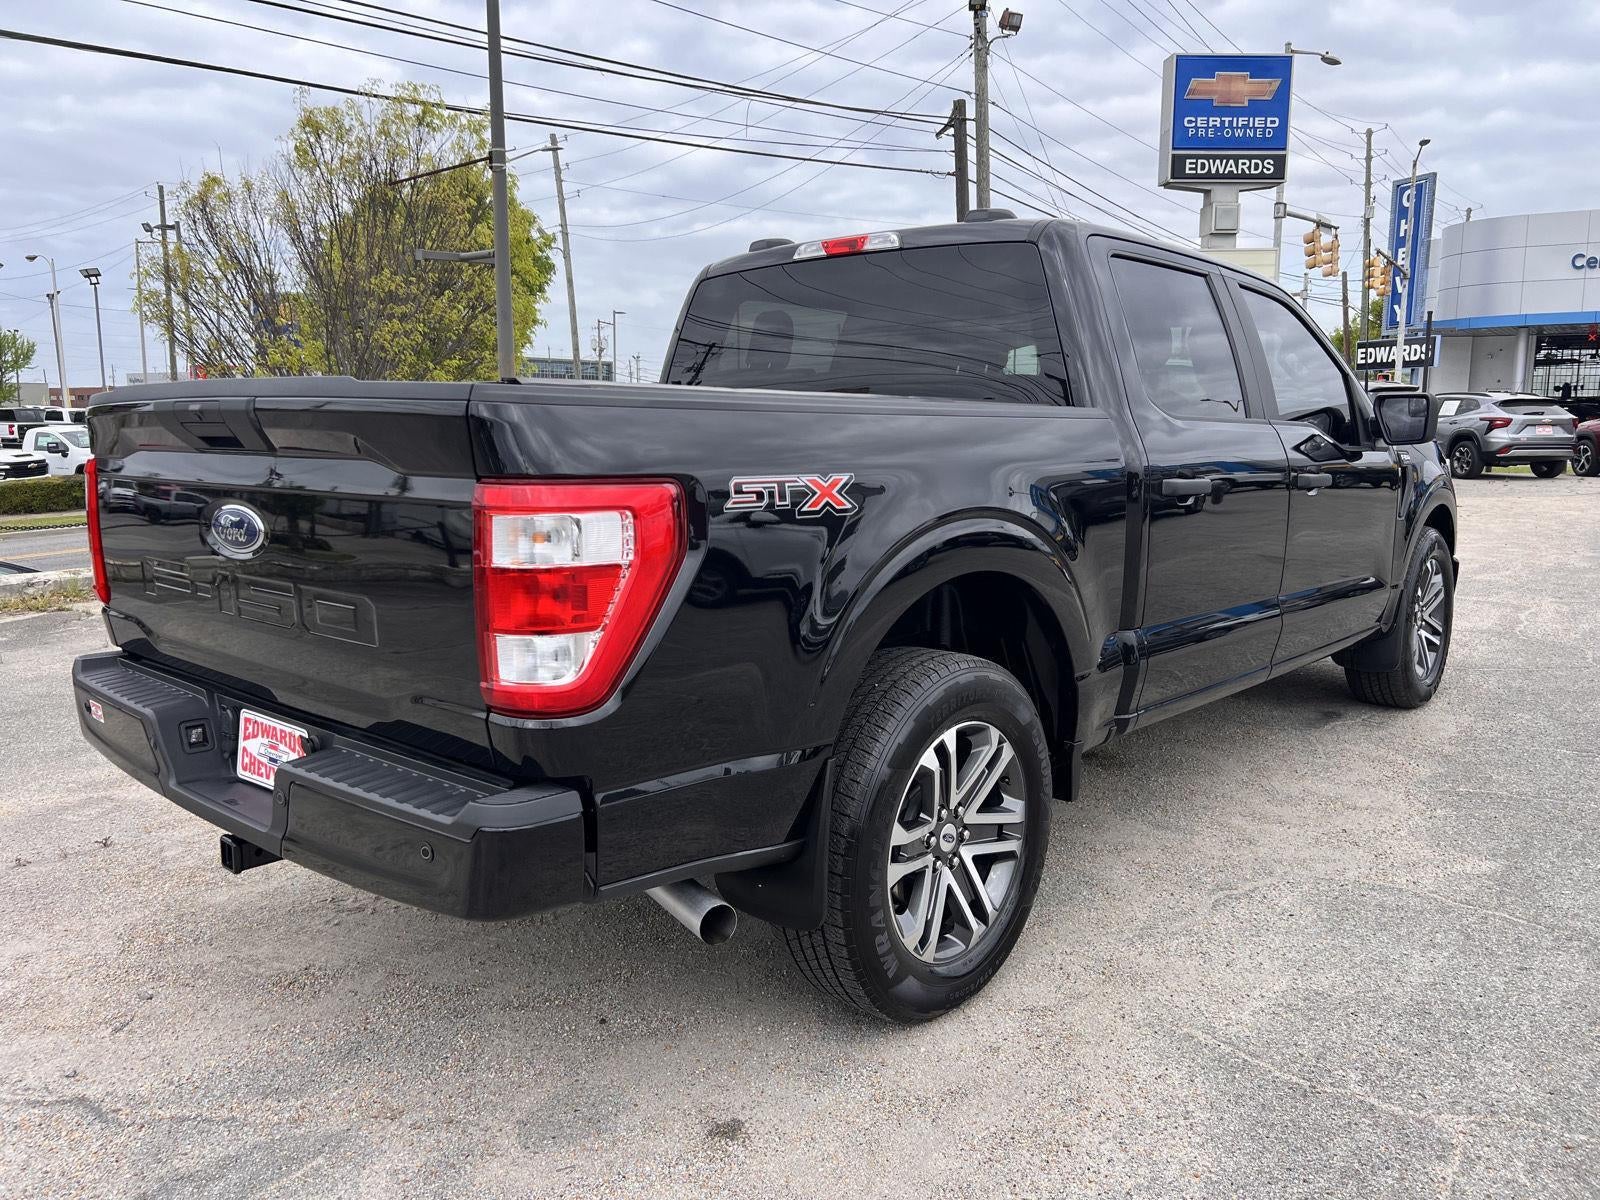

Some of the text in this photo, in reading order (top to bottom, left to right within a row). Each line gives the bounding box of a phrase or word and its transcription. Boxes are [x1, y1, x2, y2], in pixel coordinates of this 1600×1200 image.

[1184, 117, 1279, 128] CERTIFIED
[1189, 129, 1273, 137] PRE-OWNED
[1185, 159, 1274, 174] EDWARDS
[1571, 253, 1600, 270] Ce
[724, 474, 858, 518] STX
[218, 514, 248, 543] Ford
[143, 556, 380, 648] F-150
[243, 716, 306, 758] EDWARDS
[241, 745, 277, 780] CHEV
